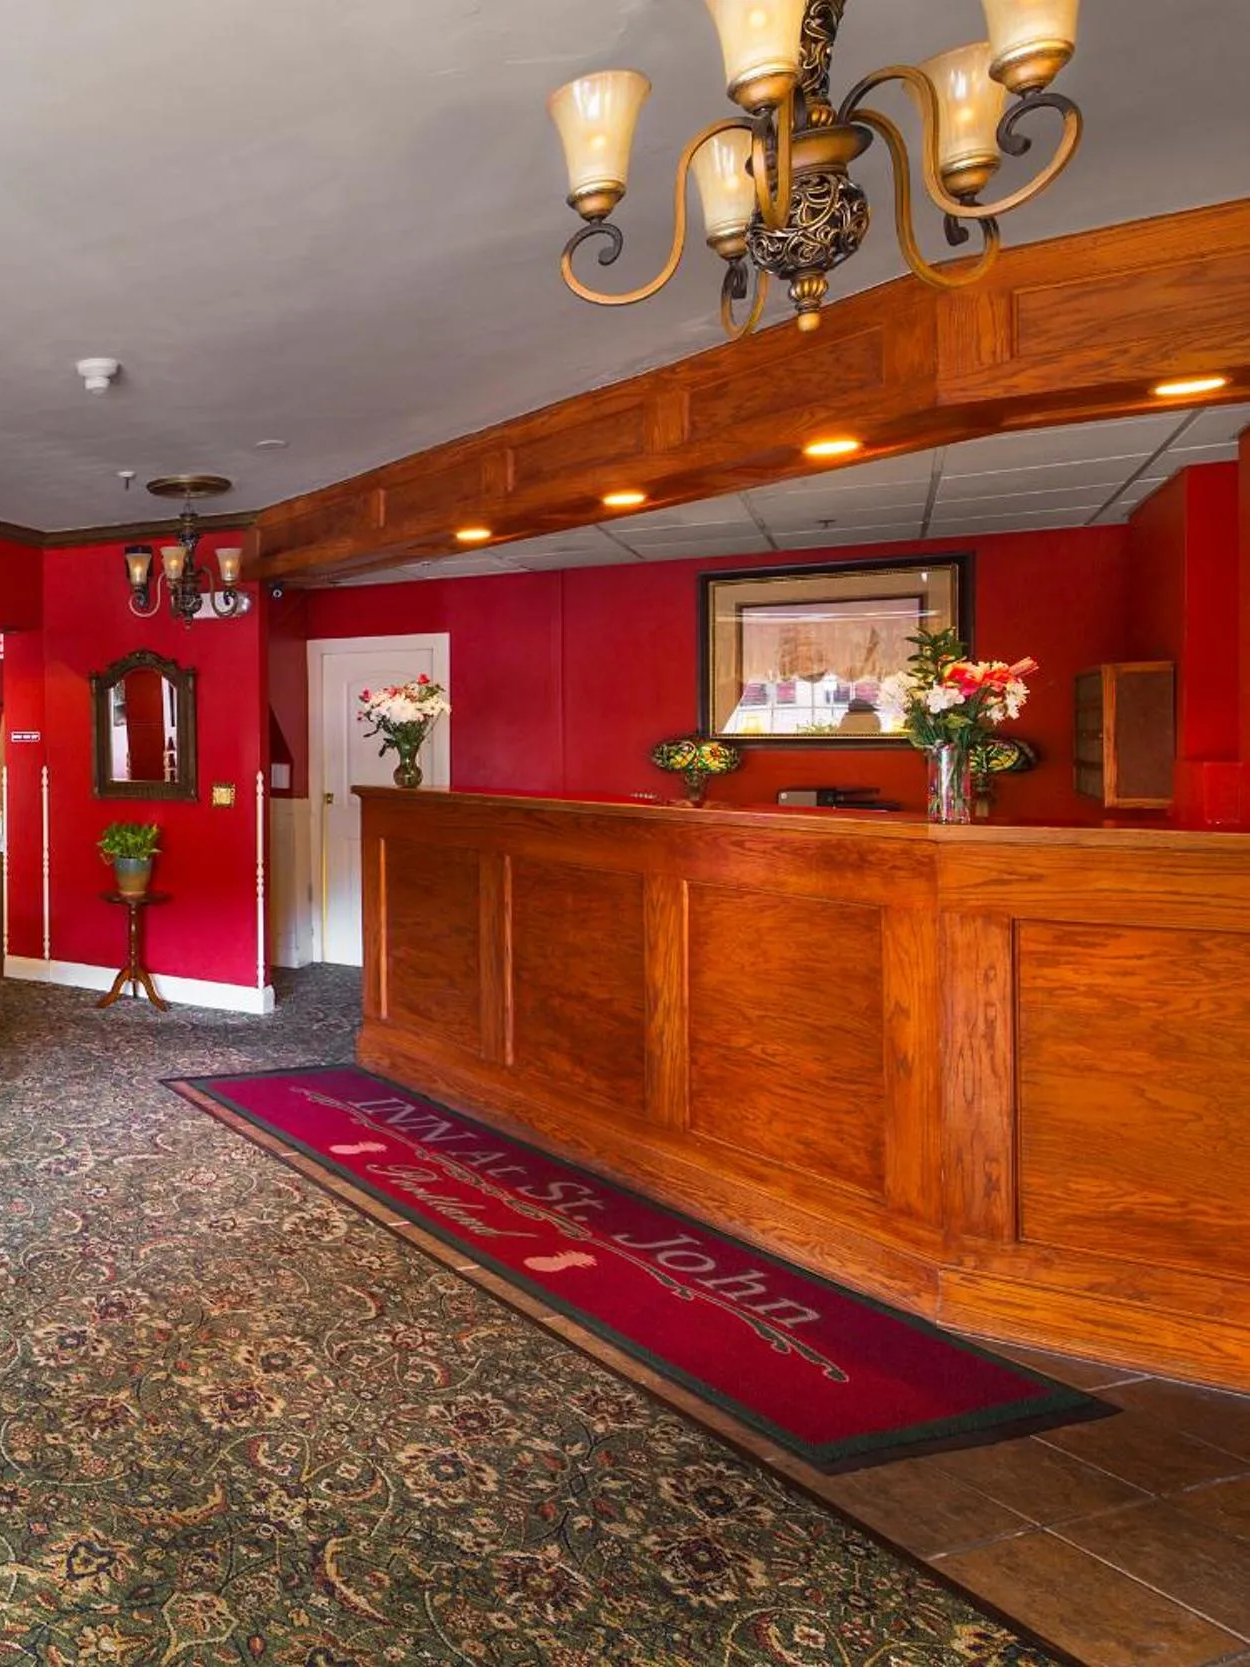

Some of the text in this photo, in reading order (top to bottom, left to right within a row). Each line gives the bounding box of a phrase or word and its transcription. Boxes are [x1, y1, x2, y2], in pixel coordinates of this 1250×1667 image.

[348, 1098, 478, 1142] INN
[515, 1182, 605, 1222] St.
[611, 1233, 821, 1328] John
